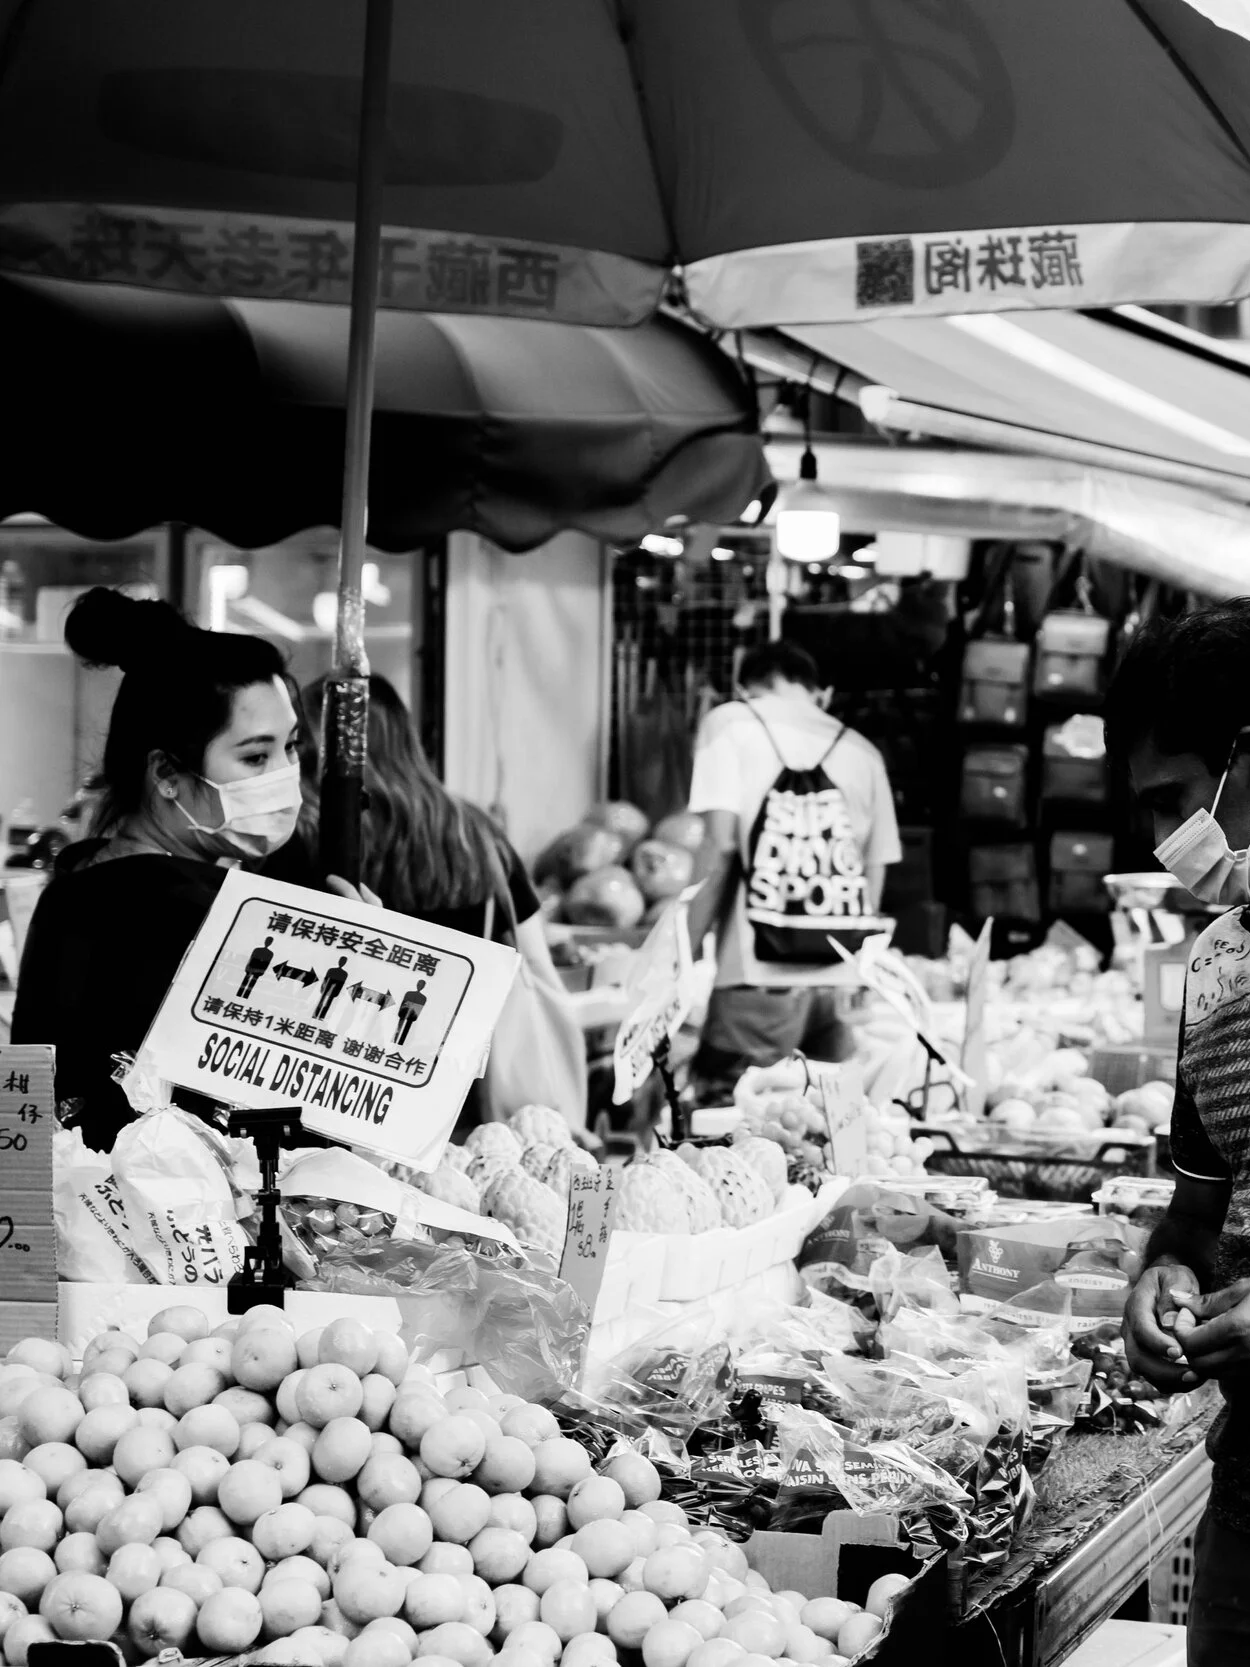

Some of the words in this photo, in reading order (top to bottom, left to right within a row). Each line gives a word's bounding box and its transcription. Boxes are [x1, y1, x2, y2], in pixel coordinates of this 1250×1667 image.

[749, 872, 873, 916] SPORT
[267, 910, 441, 978] 请保持安全距离
[202, 995, 339, 1050] 请保持1米距离
[341, 1036, 428, 1078] 谢谢合作
[197, 1031, 275, 1087] SOCIAL
[270, 1050, 395, 1126] DISTANCING
[971, 1257, 1021, 1279] ANTHONY
[786, 1474, 824, 1487] AISIN
